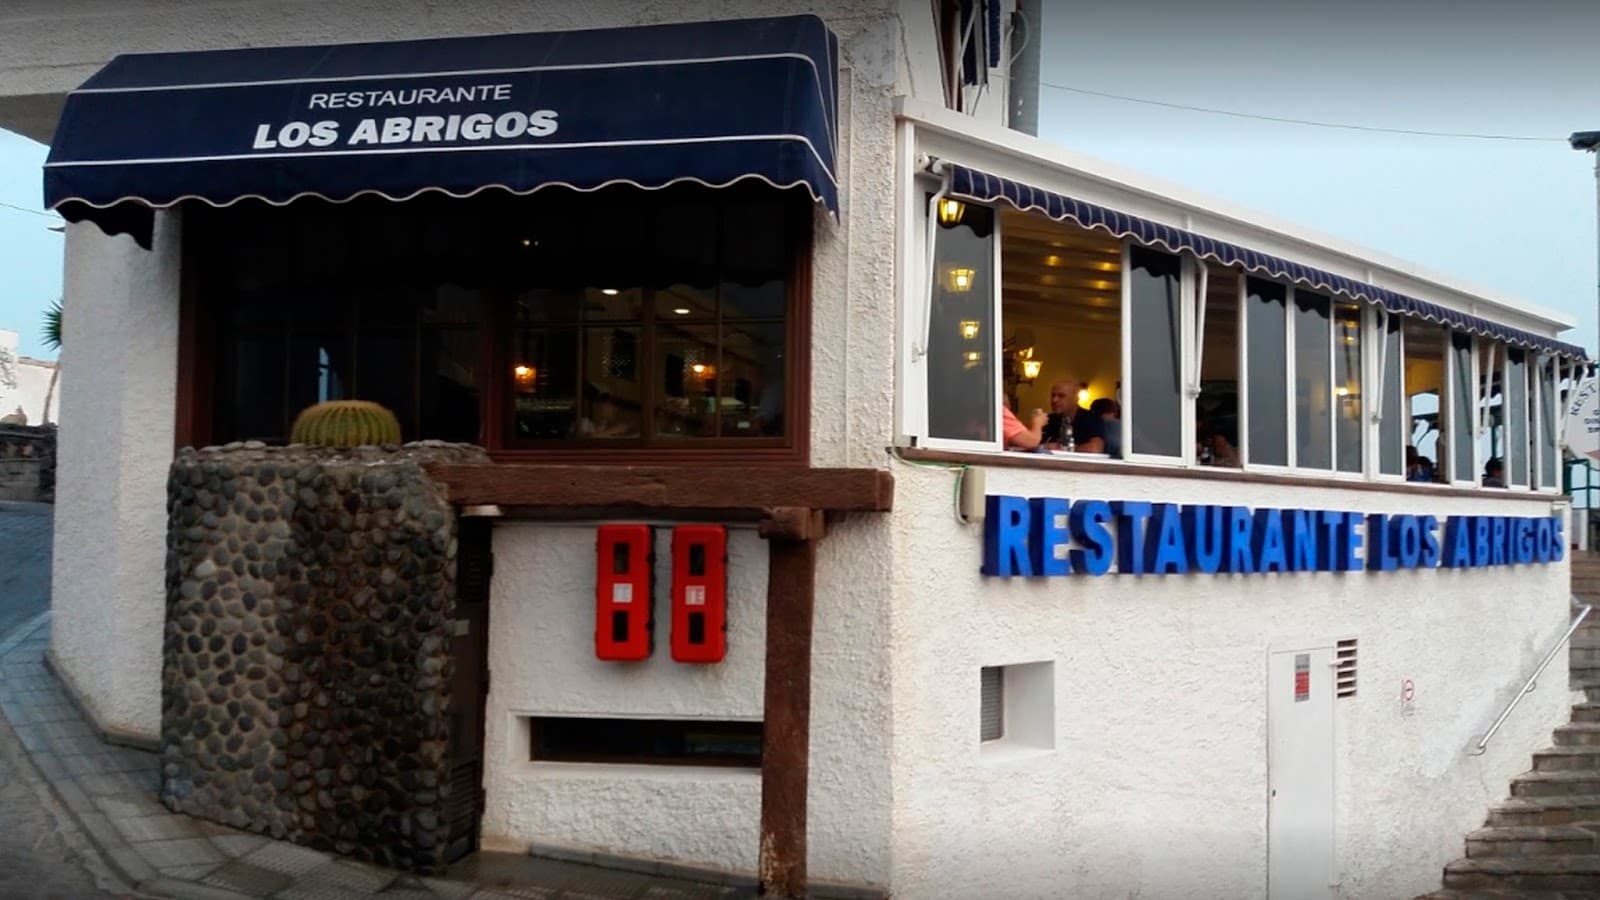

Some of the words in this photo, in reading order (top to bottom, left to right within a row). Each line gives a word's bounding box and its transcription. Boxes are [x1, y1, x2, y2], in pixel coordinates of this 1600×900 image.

[308, 84, 512, 109] RESTAURANTE
[253, 120, 340, 149] LOS
[348, 109, 559, 145] ABRIGOS
[984, 495, 1365, 577] RESTAURANTE
[1367, 513, 1441, 572] LOS
[1443, 515, 1565, 569] ABRIGOS
